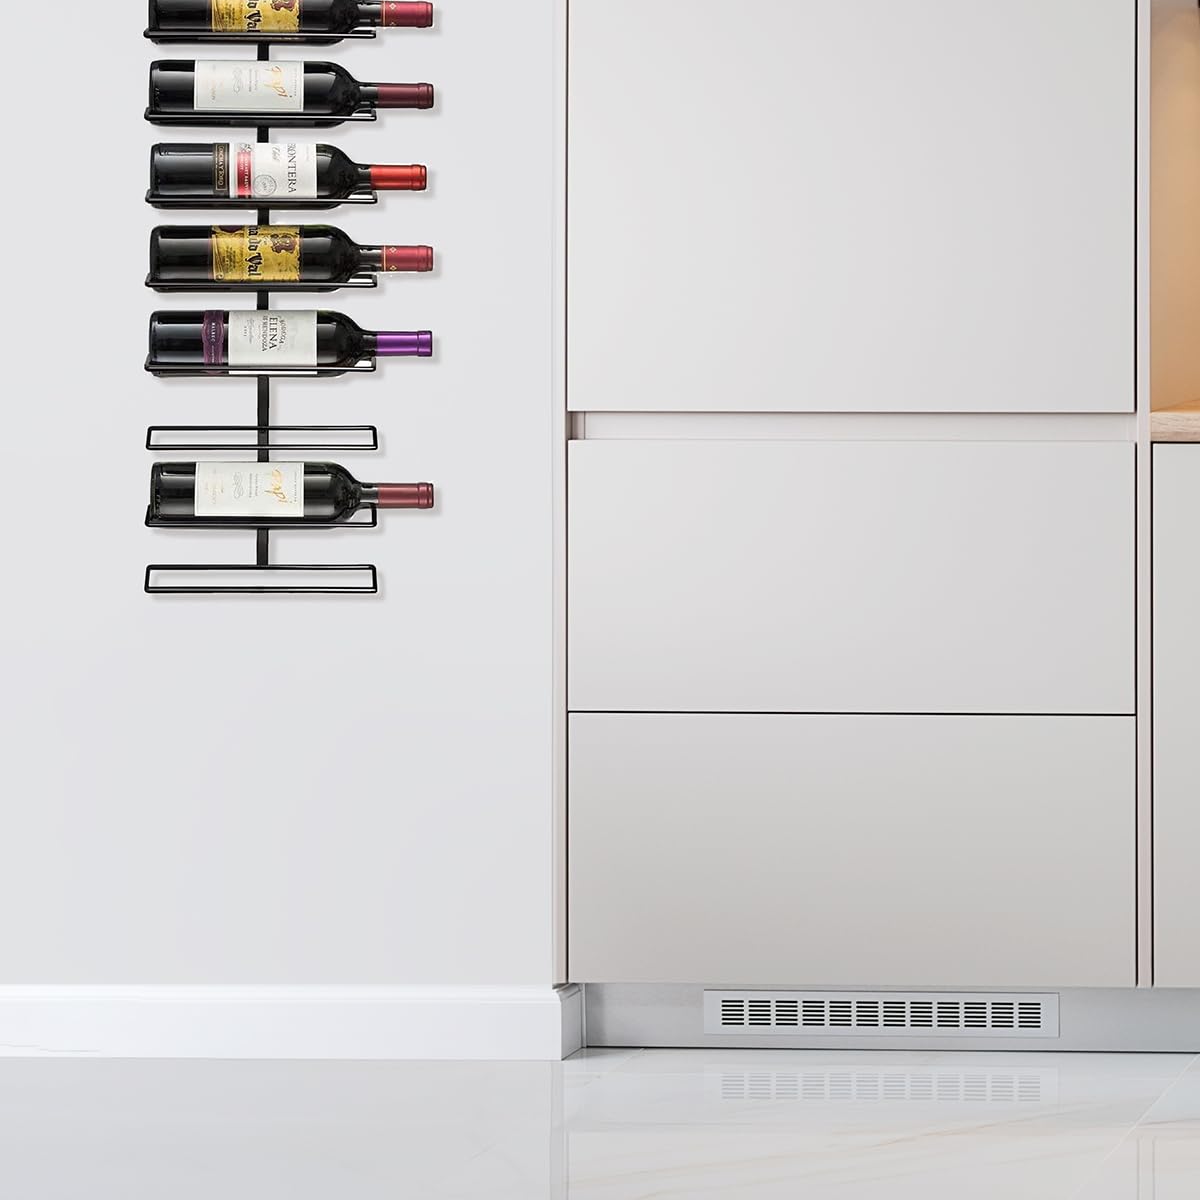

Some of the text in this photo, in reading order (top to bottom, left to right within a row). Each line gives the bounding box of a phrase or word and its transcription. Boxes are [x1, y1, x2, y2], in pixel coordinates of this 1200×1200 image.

[244, 252, 263, 276] Val
[261, 321, 269, 352] MENDOZA
[269, 317, 278, 350] ELENA
[279, 319, 287, 344] BODEGA
